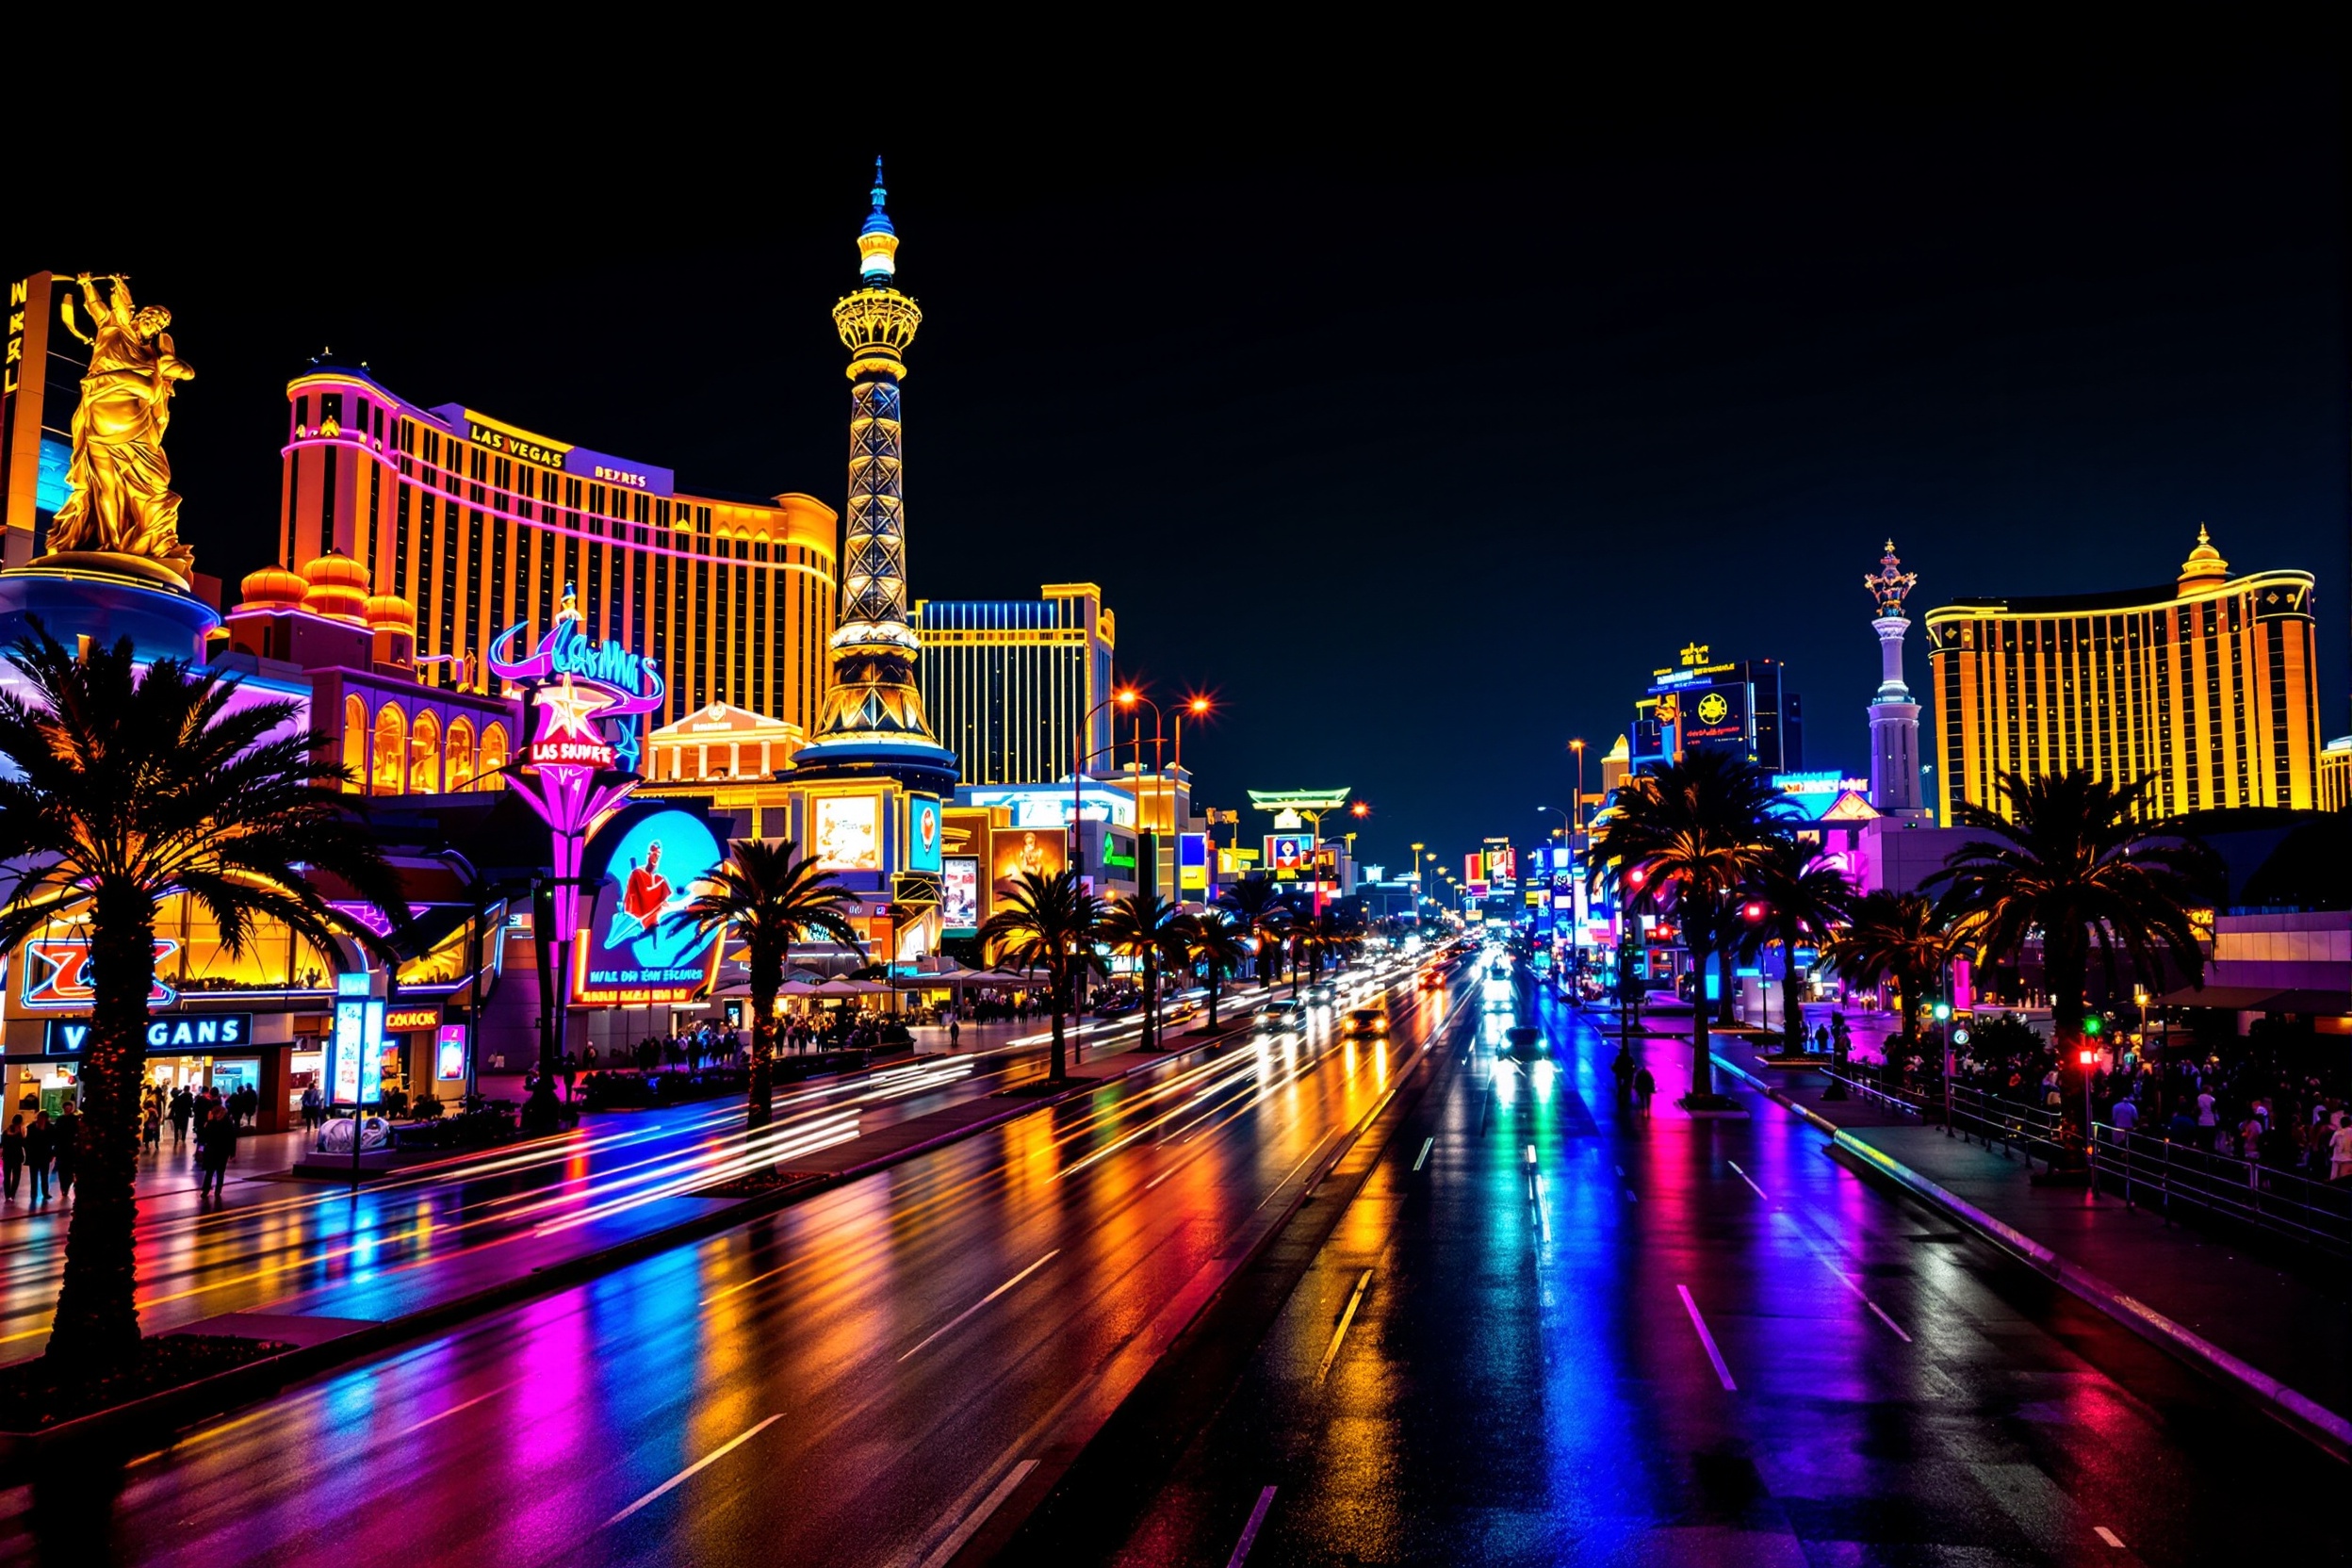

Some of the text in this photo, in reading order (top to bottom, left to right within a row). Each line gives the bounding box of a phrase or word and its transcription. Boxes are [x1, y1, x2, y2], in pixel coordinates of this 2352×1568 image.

[471, 425, 563, 467] LAS VEGAS
[533, 743, 558, 760] LAS
